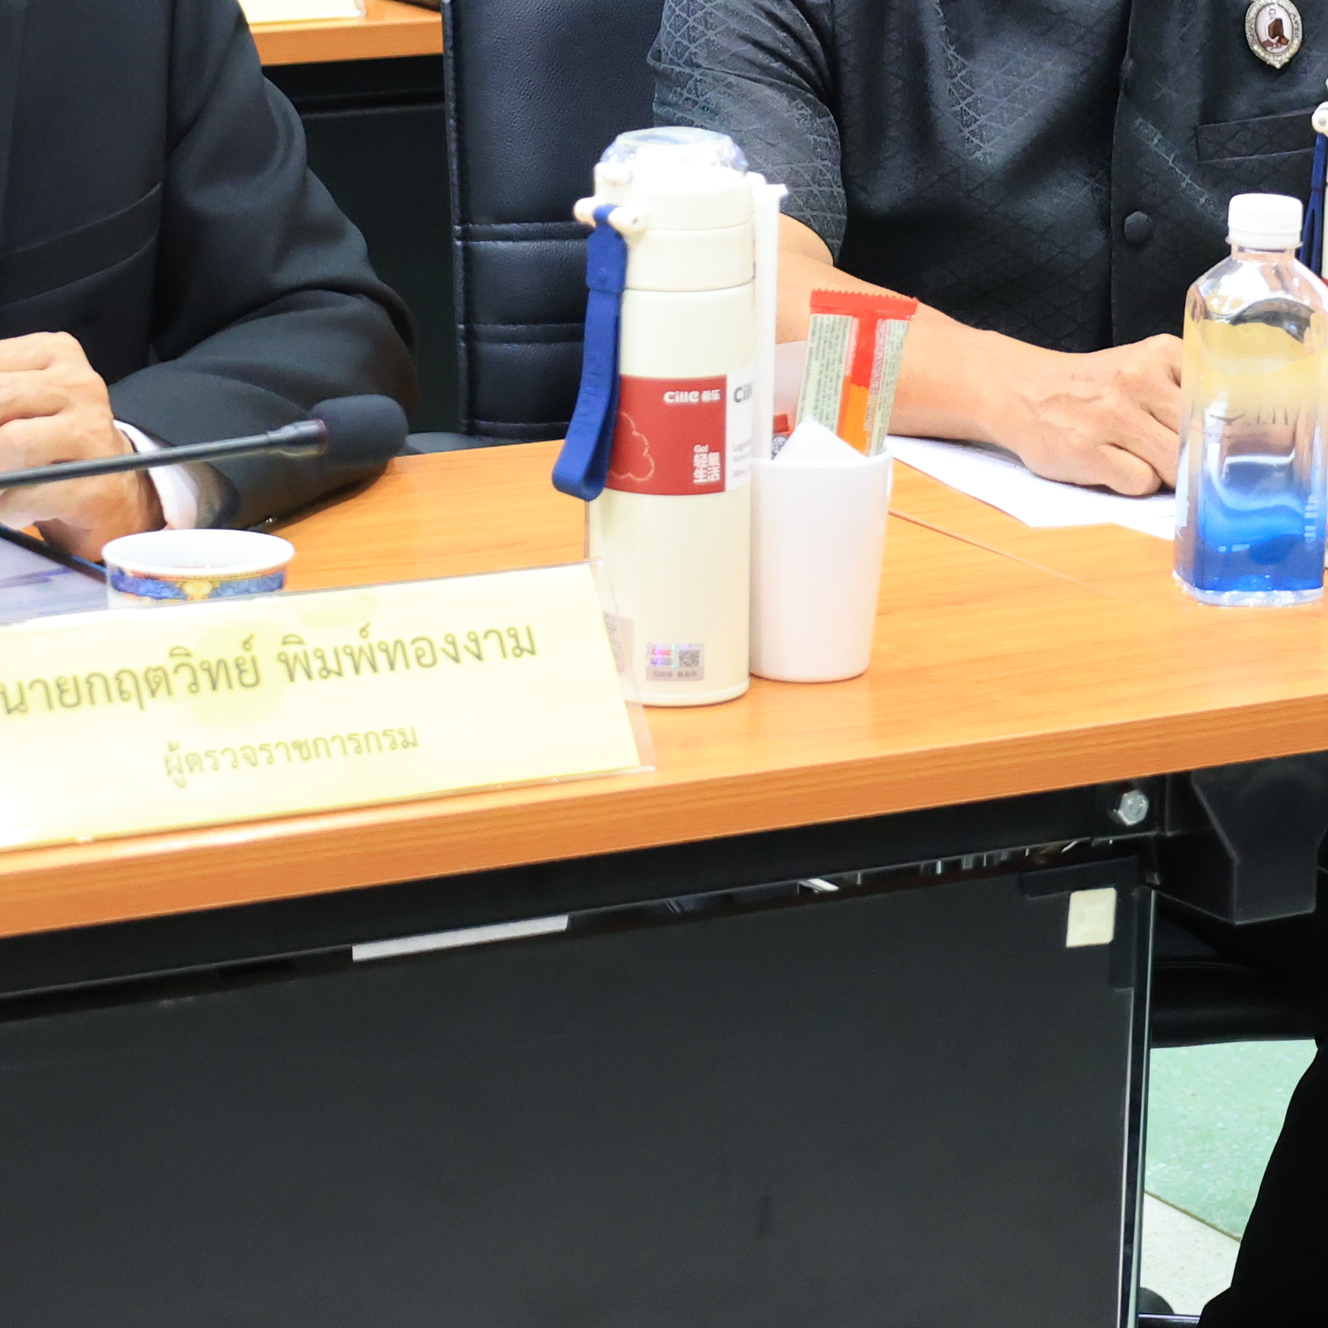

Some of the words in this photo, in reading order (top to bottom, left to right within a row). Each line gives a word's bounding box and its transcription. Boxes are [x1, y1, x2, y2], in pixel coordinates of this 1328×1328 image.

[276, 622, 538, 684] พิมพ์ทองงาม
[163, 726, 420, 789] ผู้ตรวจราชการกรม
